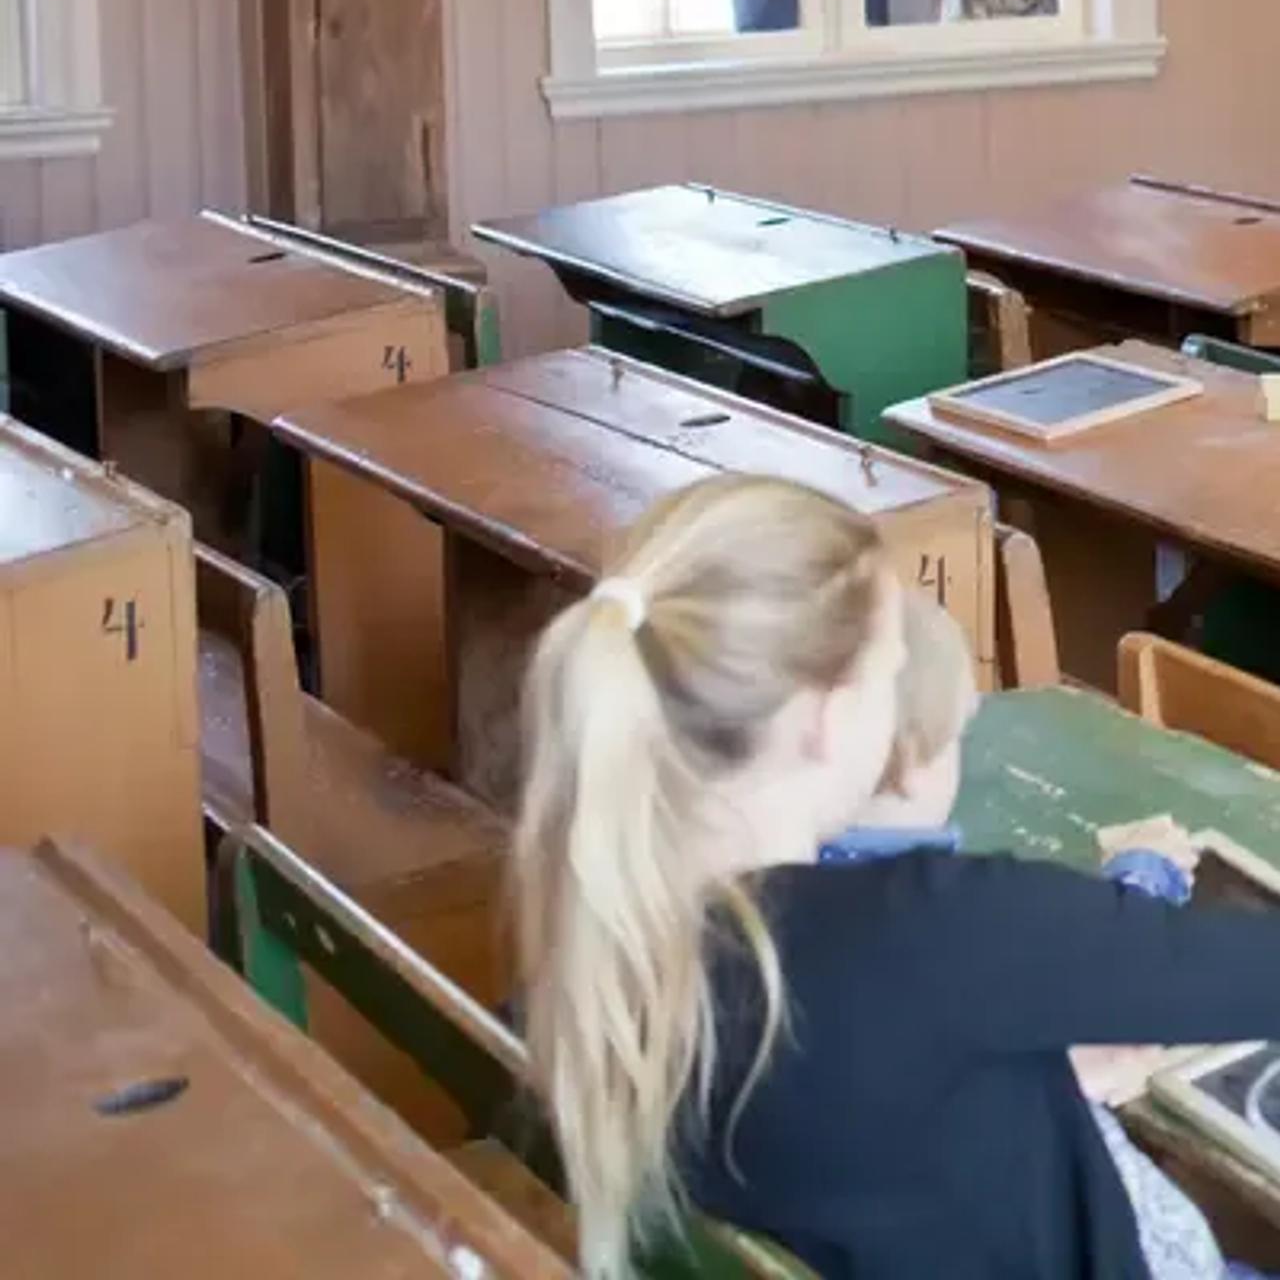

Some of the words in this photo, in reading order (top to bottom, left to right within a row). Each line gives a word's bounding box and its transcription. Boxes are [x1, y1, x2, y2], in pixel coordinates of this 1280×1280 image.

[381, 345, 413, 384] 4
[919, 554, 952, 608] 4
[102, 597, 145, 660] 4
